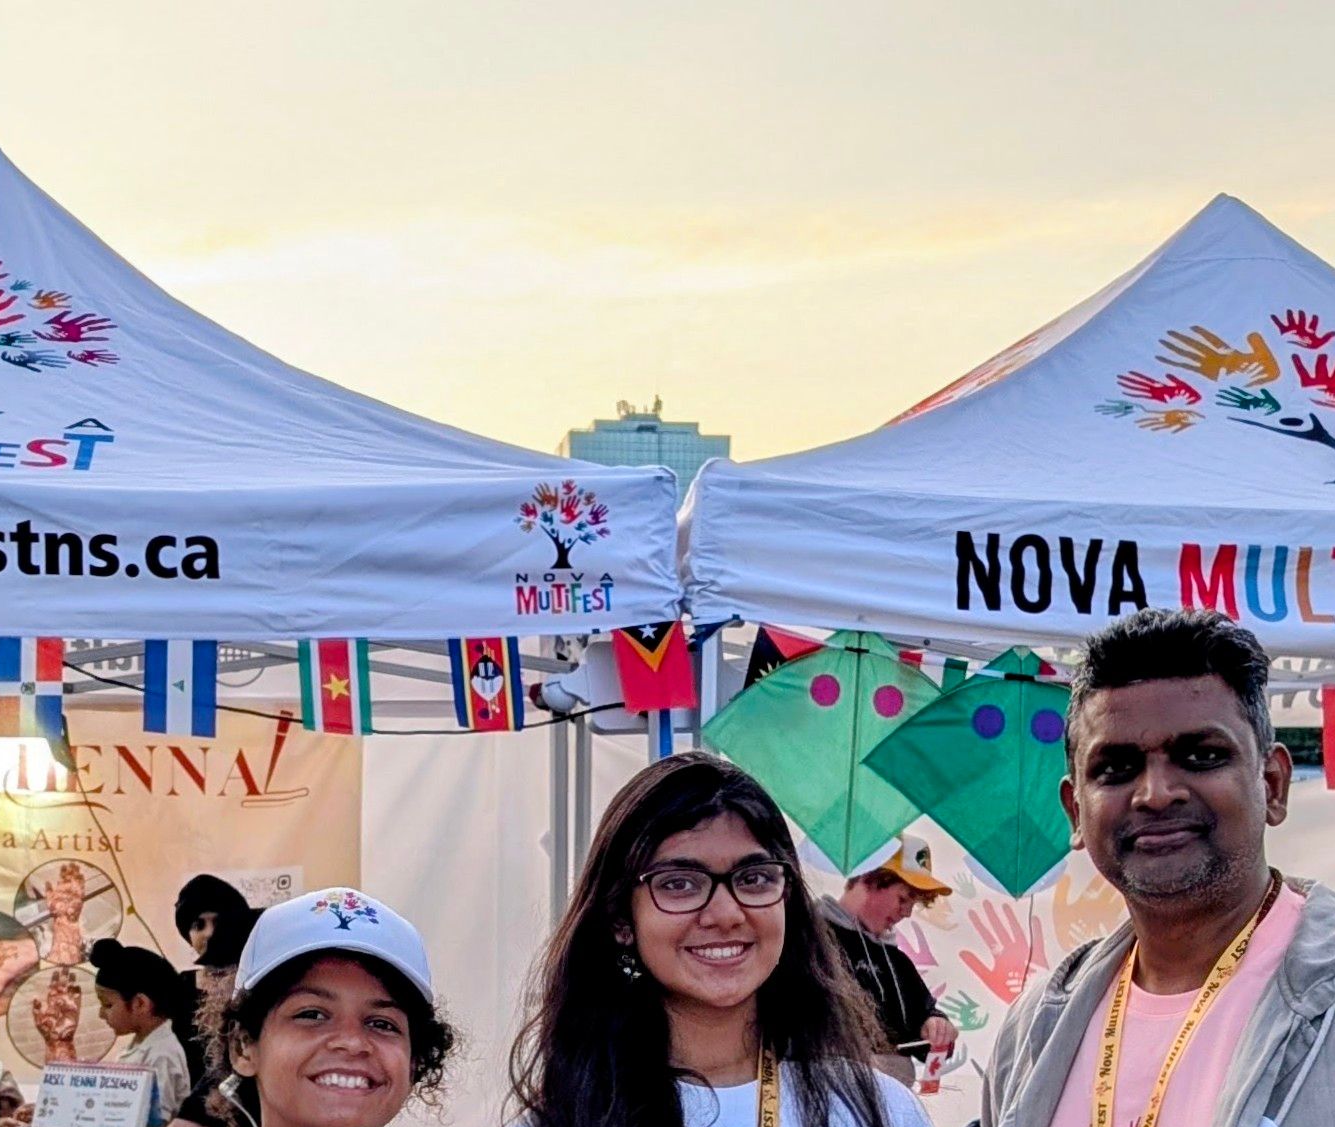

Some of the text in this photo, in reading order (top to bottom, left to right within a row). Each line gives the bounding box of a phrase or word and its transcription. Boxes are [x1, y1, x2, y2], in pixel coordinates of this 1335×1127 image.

[515, 572, 614, 583] NOVA
[955, 530, 1149, 615] NOVA
[29, 825, 125, 854] Artist
